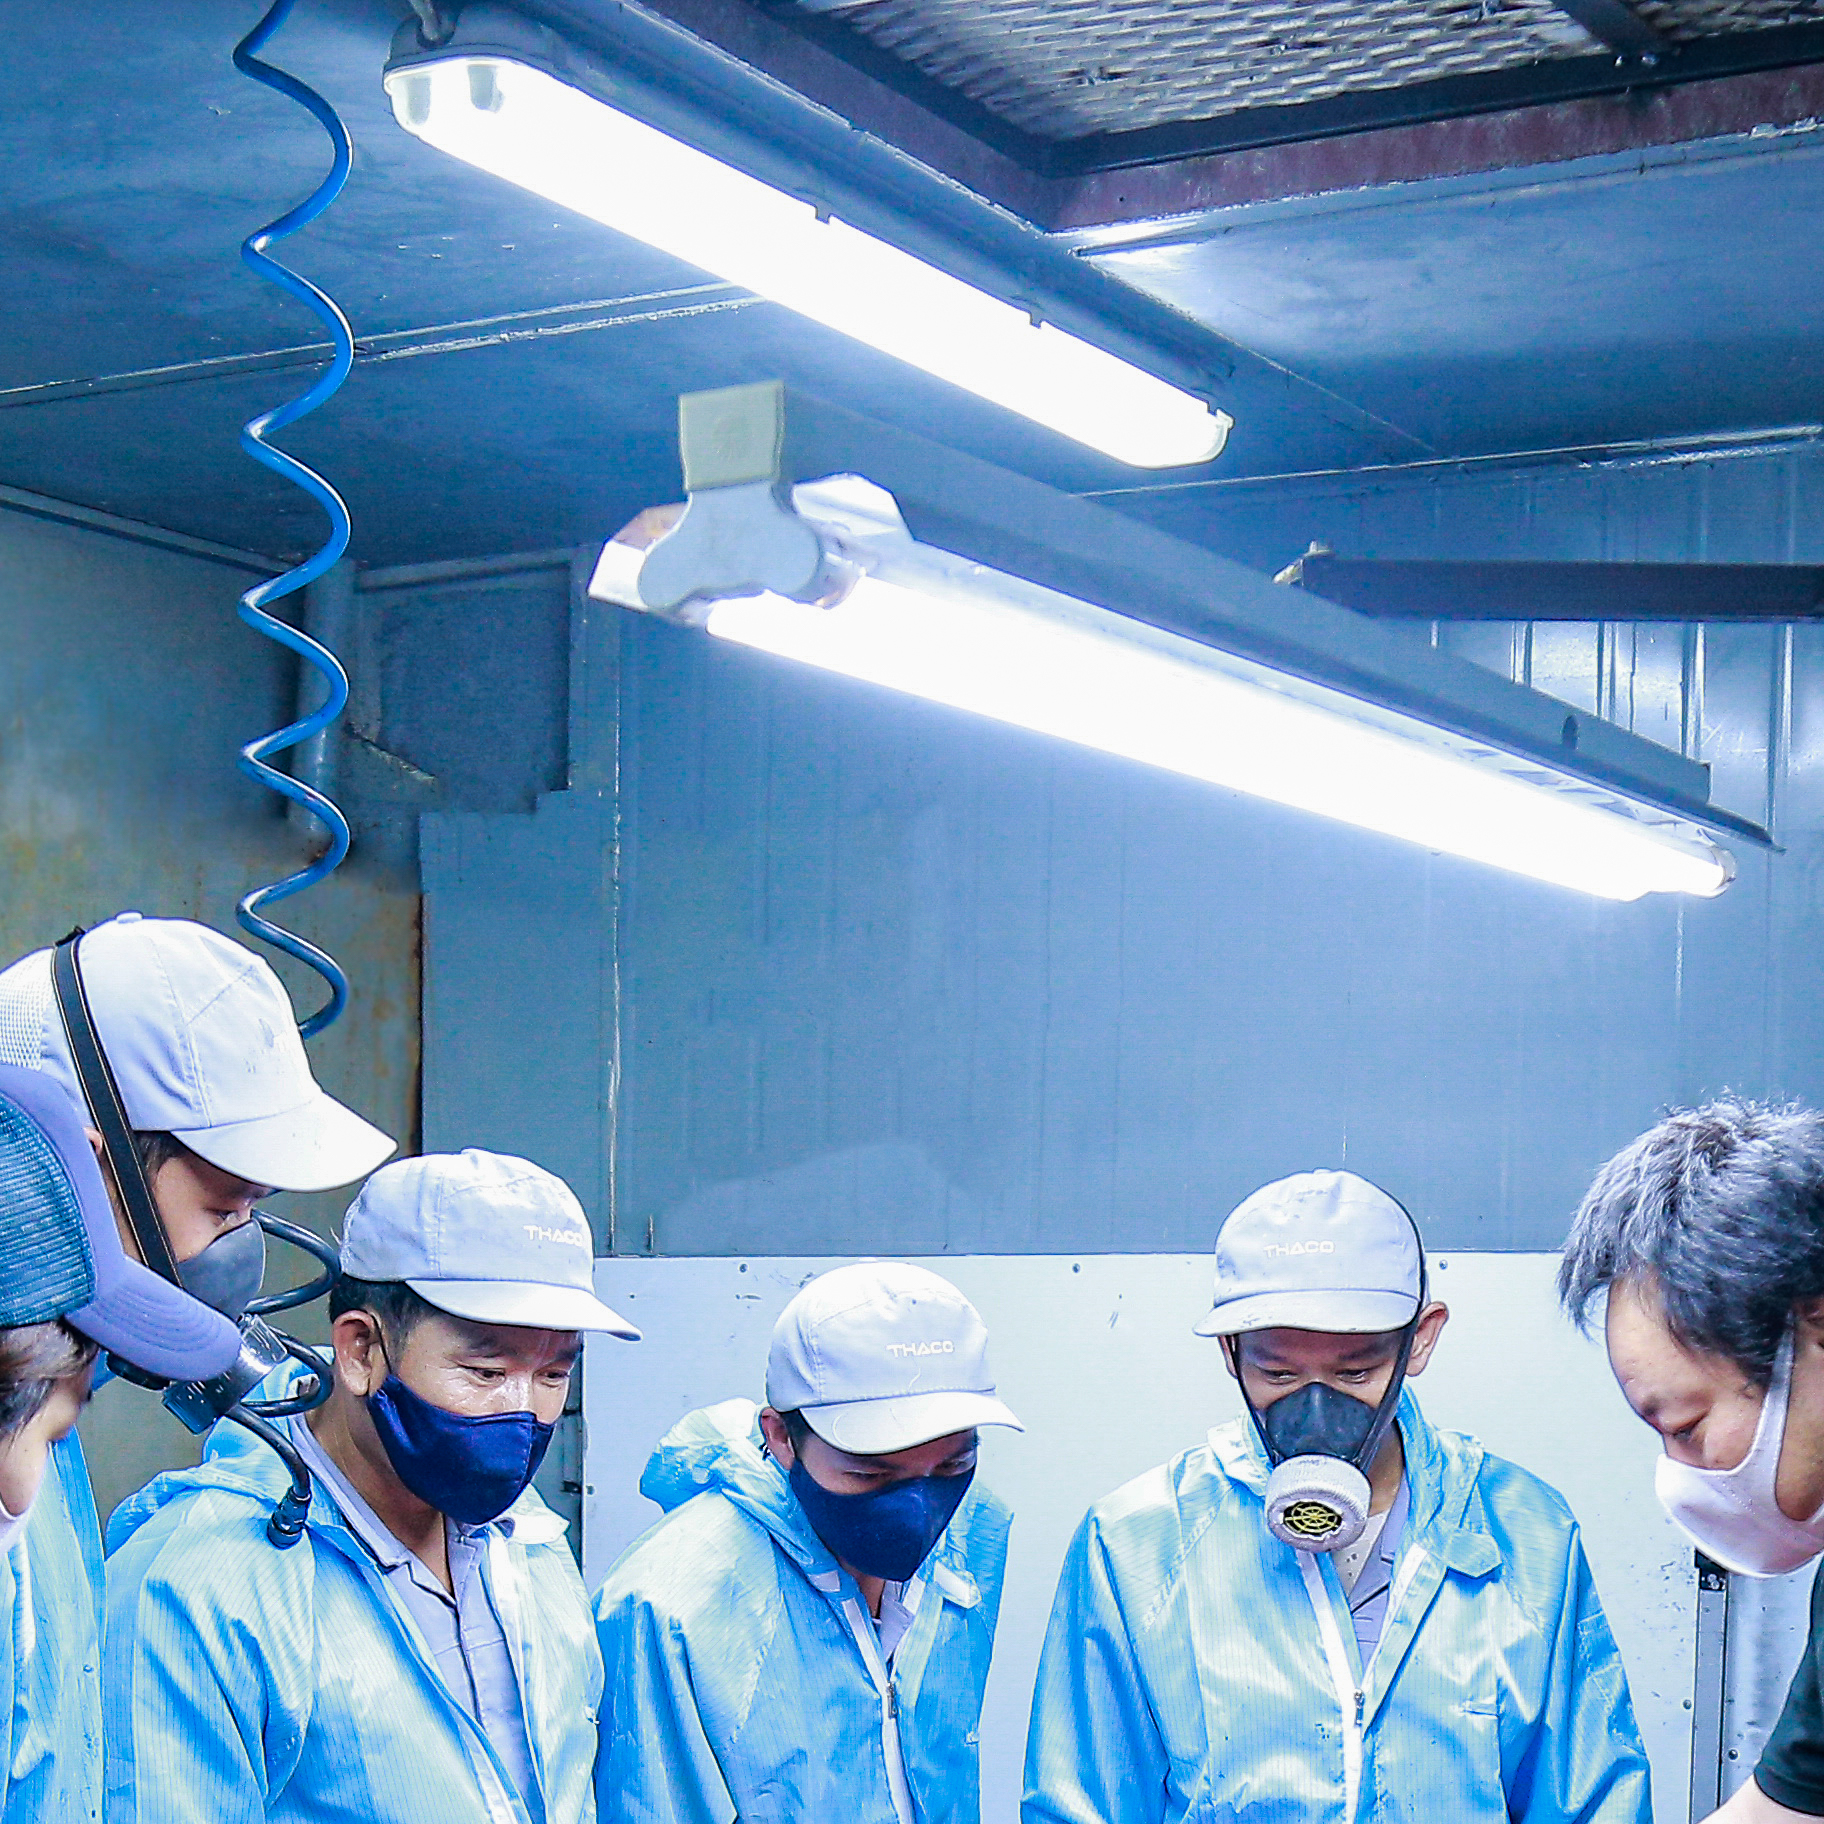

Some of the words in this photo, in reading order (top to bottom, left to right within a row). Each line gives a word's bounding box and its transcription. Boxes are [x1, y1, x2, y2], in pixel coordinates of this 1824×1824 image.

[523, 1225, 582, 1246] THACO
[1264, 1240, 1334, 1258] THACO
[886, 1341, 954, 1357] THACO
